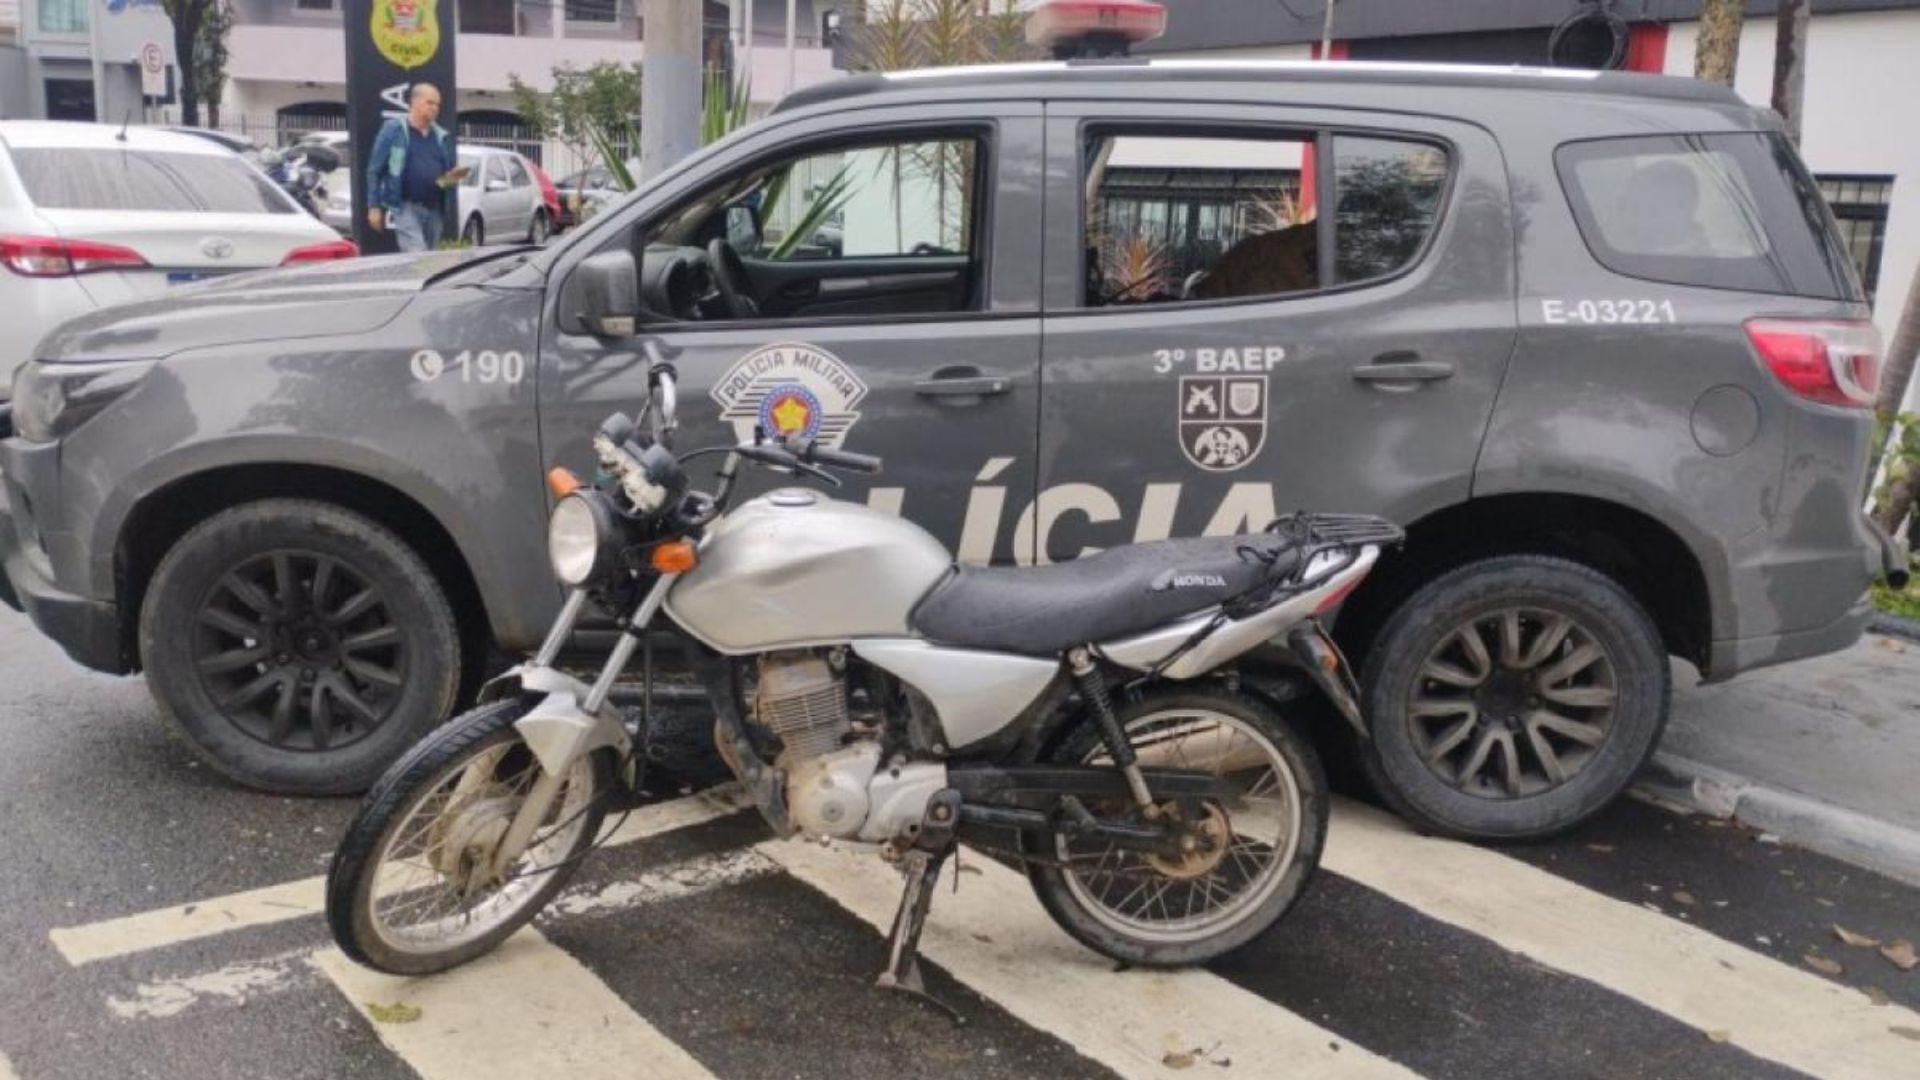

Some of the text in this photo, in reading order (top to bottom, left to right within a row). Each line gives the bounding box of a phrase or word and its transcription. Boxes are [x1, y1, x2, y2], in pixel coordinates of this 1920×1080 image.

[391, 43, 423, 56] CIVIL
[1541, 299, 1677, 325] E-03221
[454, 349, 525, 383] 190
[1196, 346, 1286, 372] BAEP
[793, 351, 855, 399] MILITAR
[1173, 575, 1227, 587] HONDA
